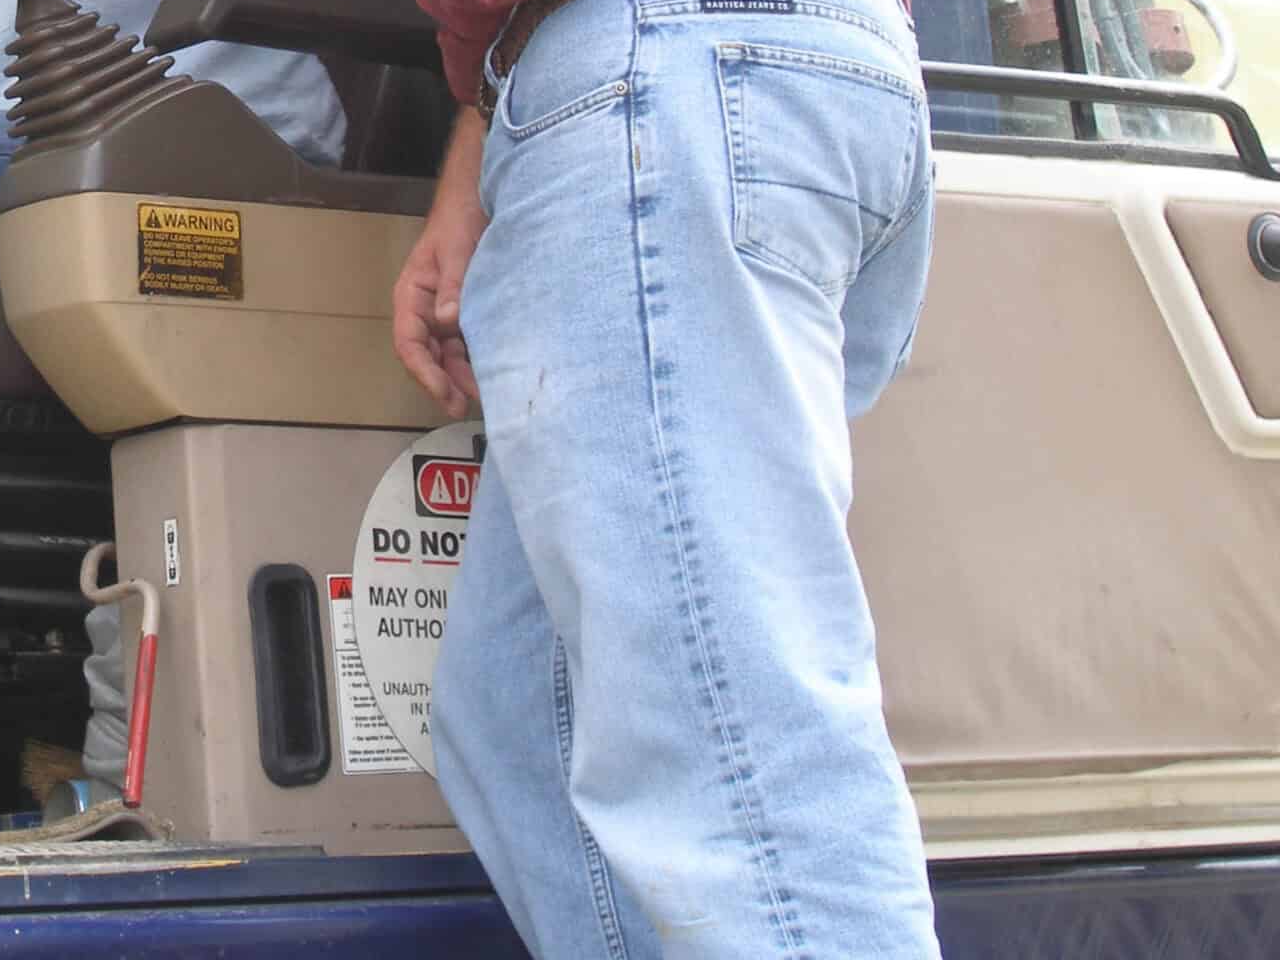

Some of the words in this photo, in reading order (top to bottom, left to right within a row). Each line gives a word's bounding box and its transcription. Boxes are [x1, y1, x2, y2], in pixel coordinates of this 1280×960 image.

[163, 213, 235, 233] WARNING
[372, 528, 411, 555] DO
[368, 586, 408, 608] MAY
[377, 617, 447, 640] AUTHO
